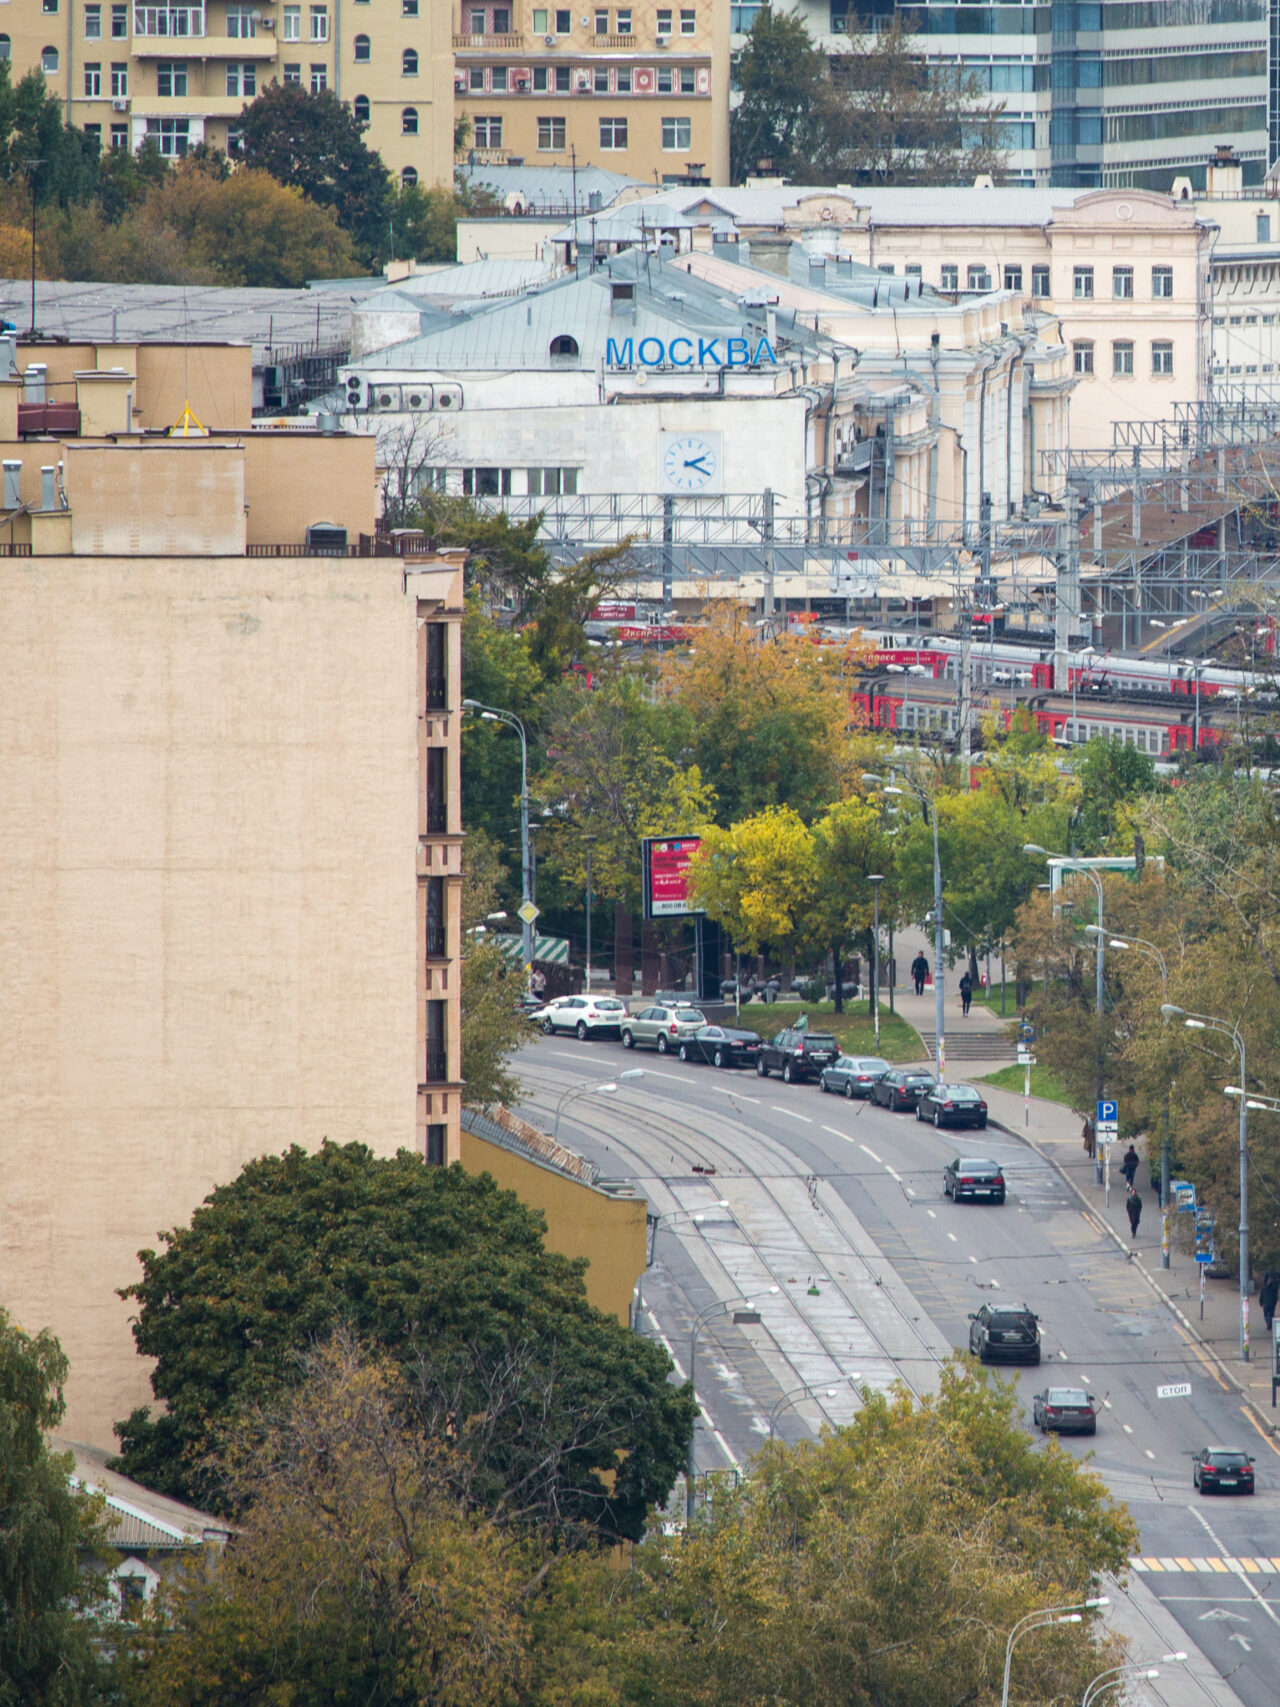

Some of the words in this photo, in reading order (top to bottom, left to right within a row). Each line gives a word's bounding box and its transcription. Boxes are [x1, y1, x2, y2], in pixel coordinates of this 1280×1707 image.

[606, 337, 777, 366] МОСКВА
[1103, 1103, 1114, 1119] P
[1162, 1385, 1187, 1396] СТОП
